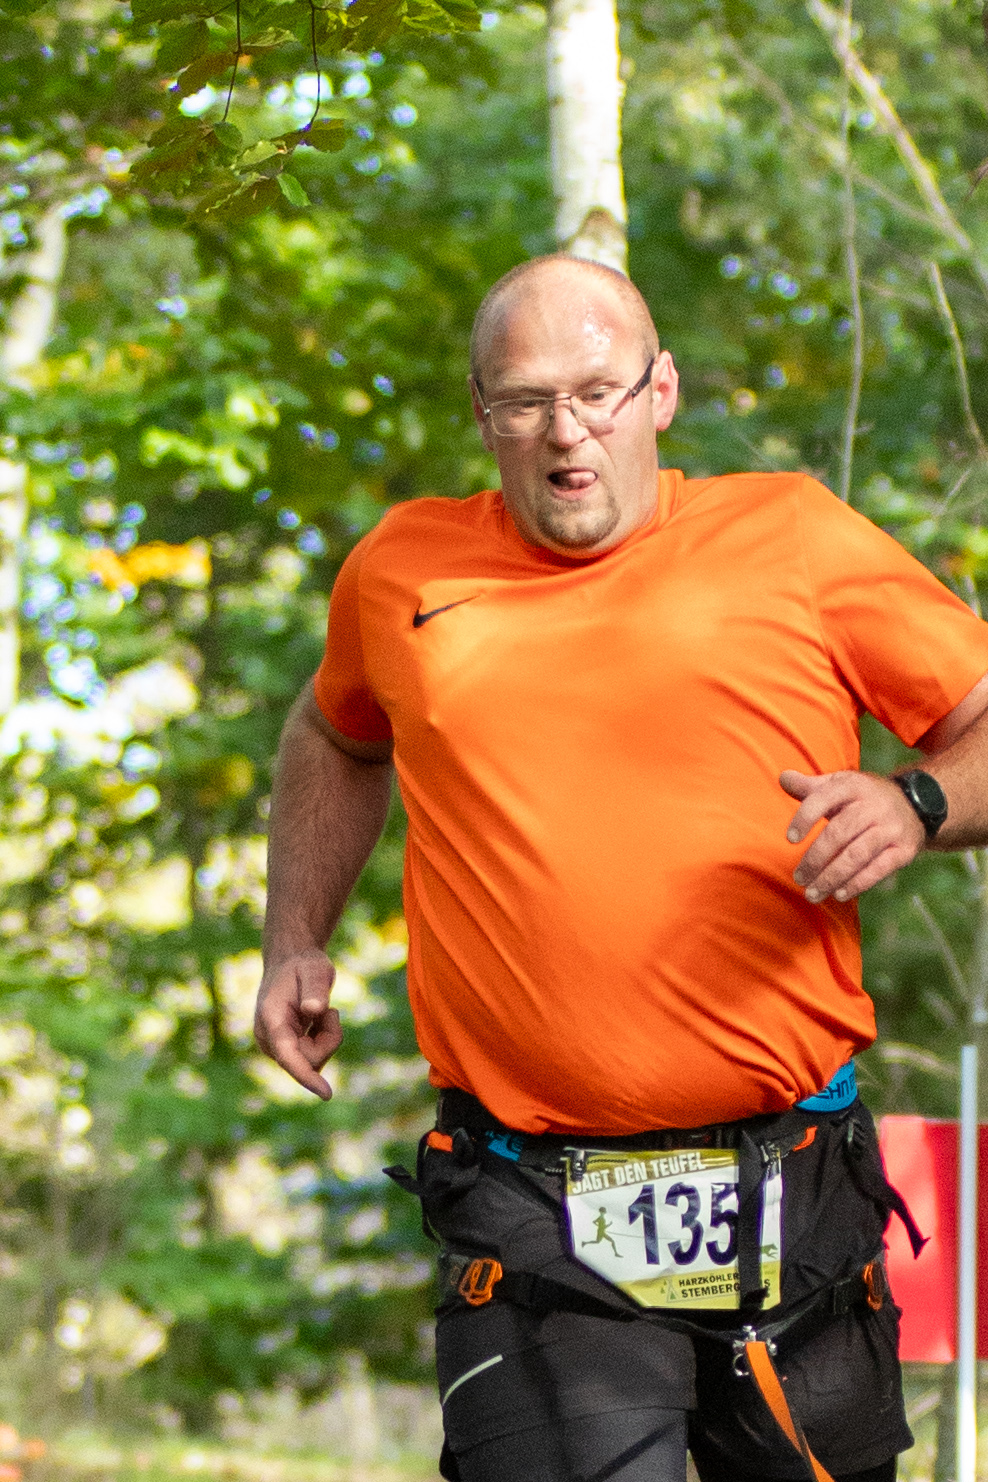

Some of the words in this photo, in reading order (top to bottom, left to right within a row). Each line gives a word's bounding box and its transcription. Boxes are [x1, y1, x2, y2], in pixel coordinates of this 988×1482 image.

[572, 1169, 610, 1194] JAGT
[614, 1162, 648, 1186] DEN
[650, 1152, 706, 1178] TEUFEL
[628, 1181, 739, 1266] 135
